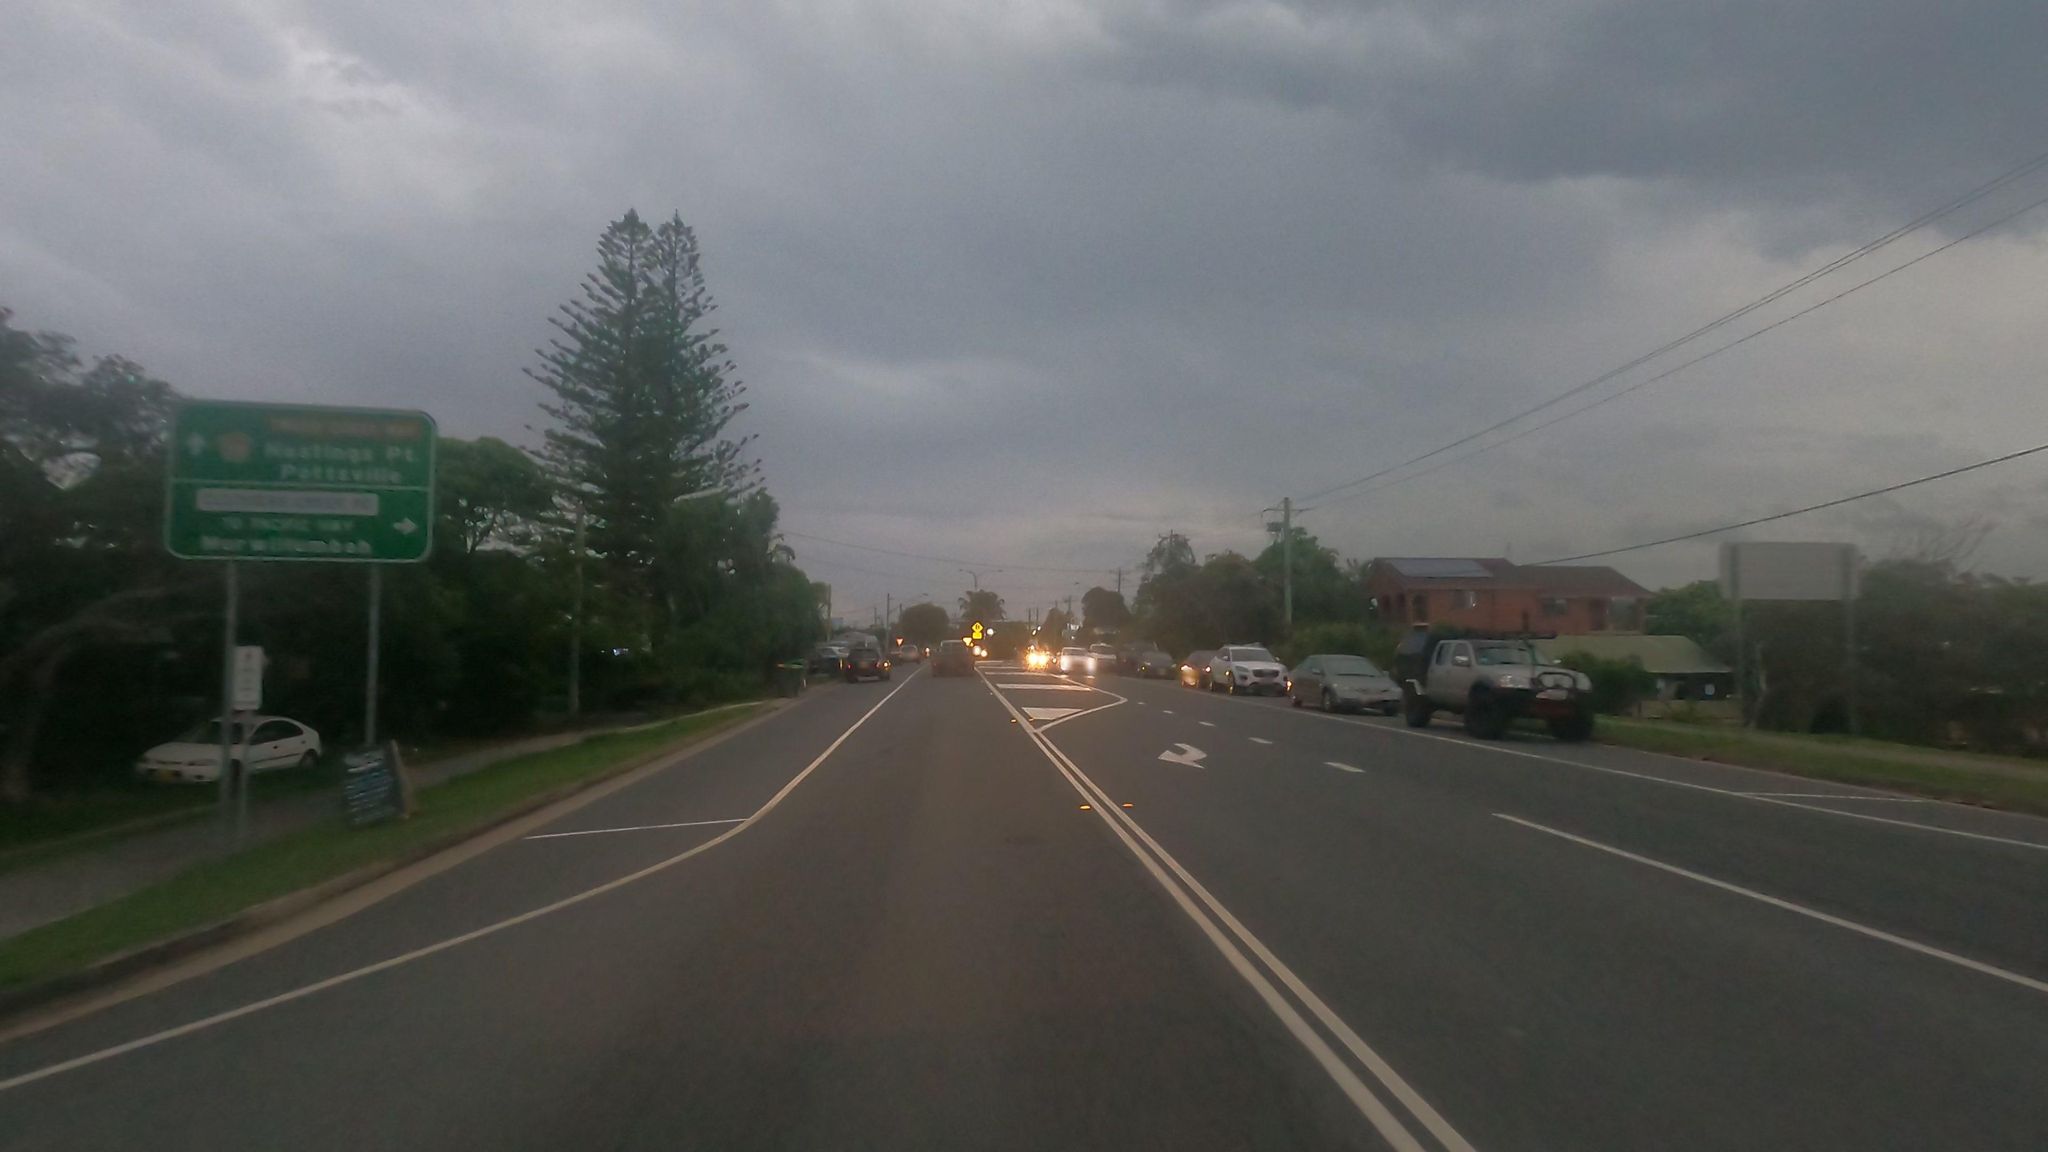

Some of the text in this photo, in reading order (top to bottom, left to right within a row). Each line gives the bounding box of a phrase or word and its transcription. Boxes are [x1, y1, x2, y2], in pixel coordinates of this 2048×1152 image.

[264, 441, 415, 464] Hastings Pt
[280, 463, 402, 484] Pottsville
